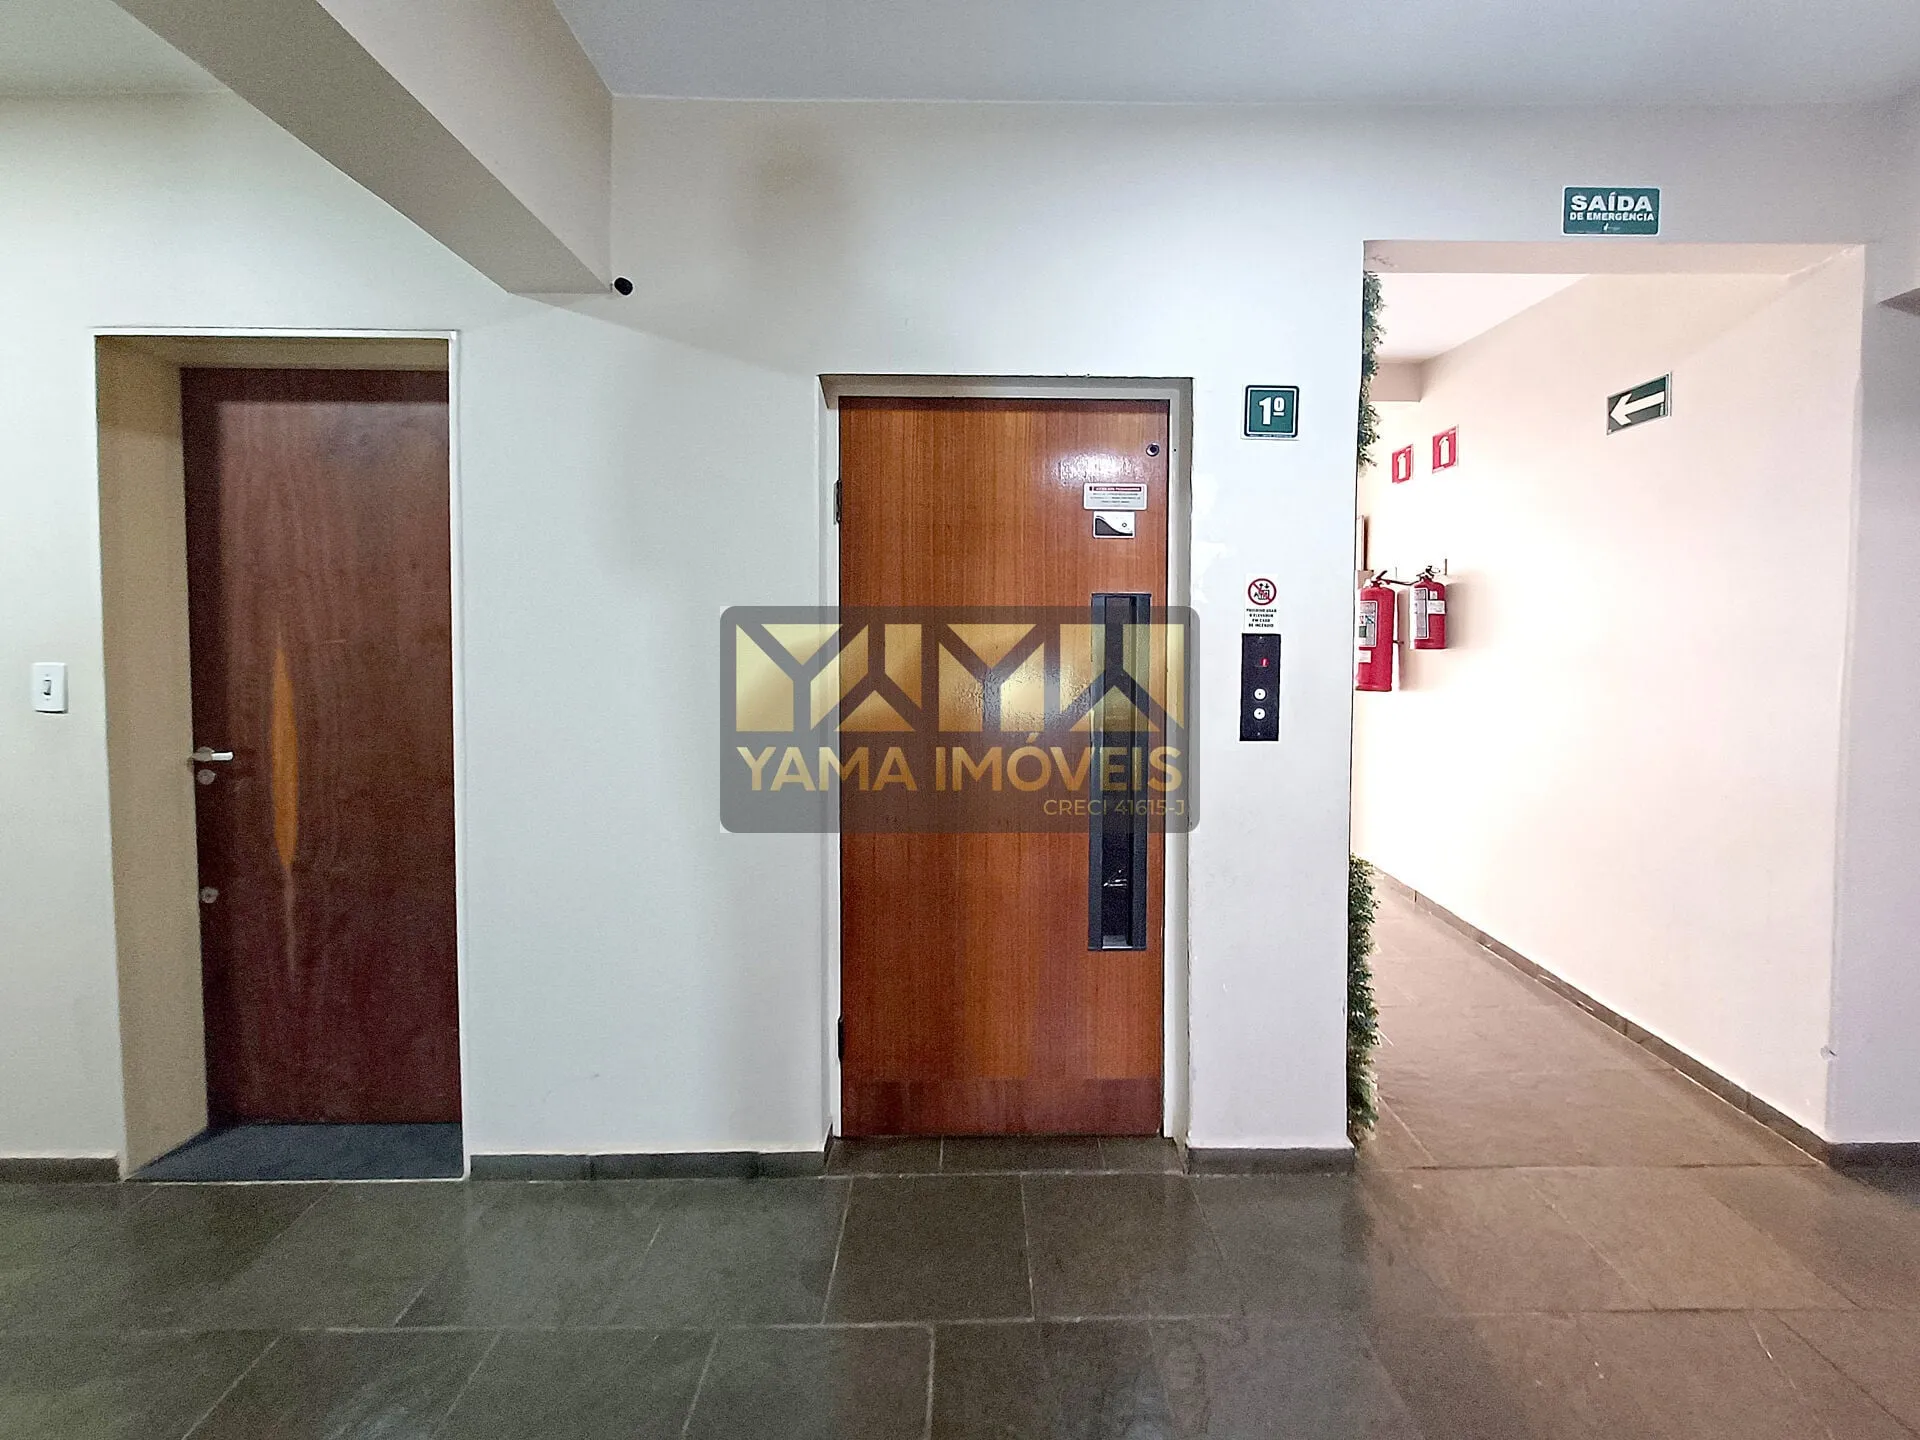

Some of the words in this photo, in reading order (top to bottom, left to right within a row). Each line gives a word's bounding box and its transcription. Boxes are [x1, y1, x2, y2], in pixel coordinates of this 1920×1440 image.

[1570, 191, 1653, 212] SAÍDA
[1569, 212, 1584, 221] DE
[1586, 211, 1655, 222] EMERGÊNCIA
